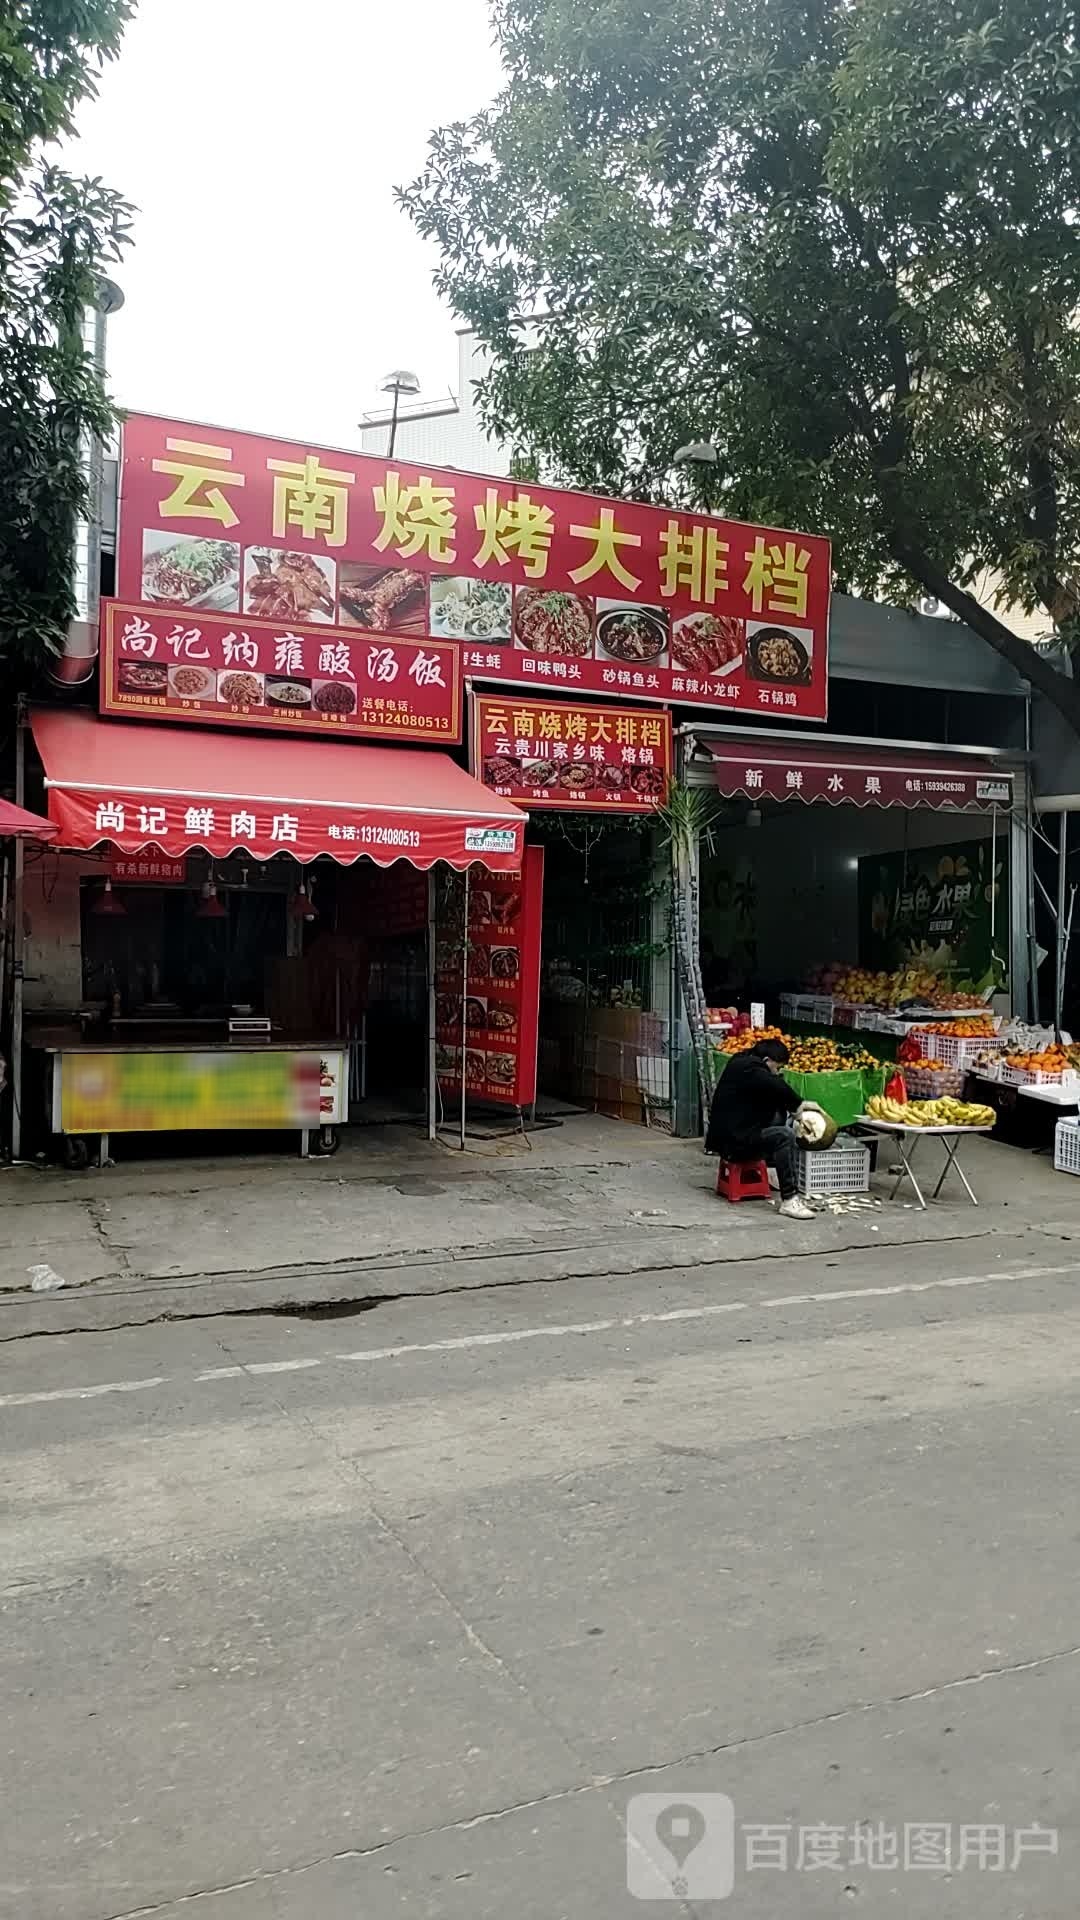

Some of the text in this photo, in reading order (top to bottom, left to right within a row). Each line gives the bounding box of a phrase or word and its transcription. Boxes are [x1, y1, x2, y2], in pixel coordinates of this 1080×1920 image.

[151, 436, 811, 618] 云南烧烤大排档
[121, 616, 447, 688] 尚记纳雍酸汤饭
[522, 658, 582, 679] 回味鸭头
[602, 669, 660, 689] 砂锅鱼头
[671, 677, 740, 700] 麻辣小龙虾
[757, 688, 797, 707] 石锅鸡
[361, 711, 449, 729] 13124080513
[485, 708, 661, 746] 云南烧烤大排档
[494, 738, 654, 764] 云贵川家乡味 烙锅
[745, 769, 881, 794] 新鲜水果
[95, 801, 420, 847] 尚记鲜肉店 电话:13124080513
